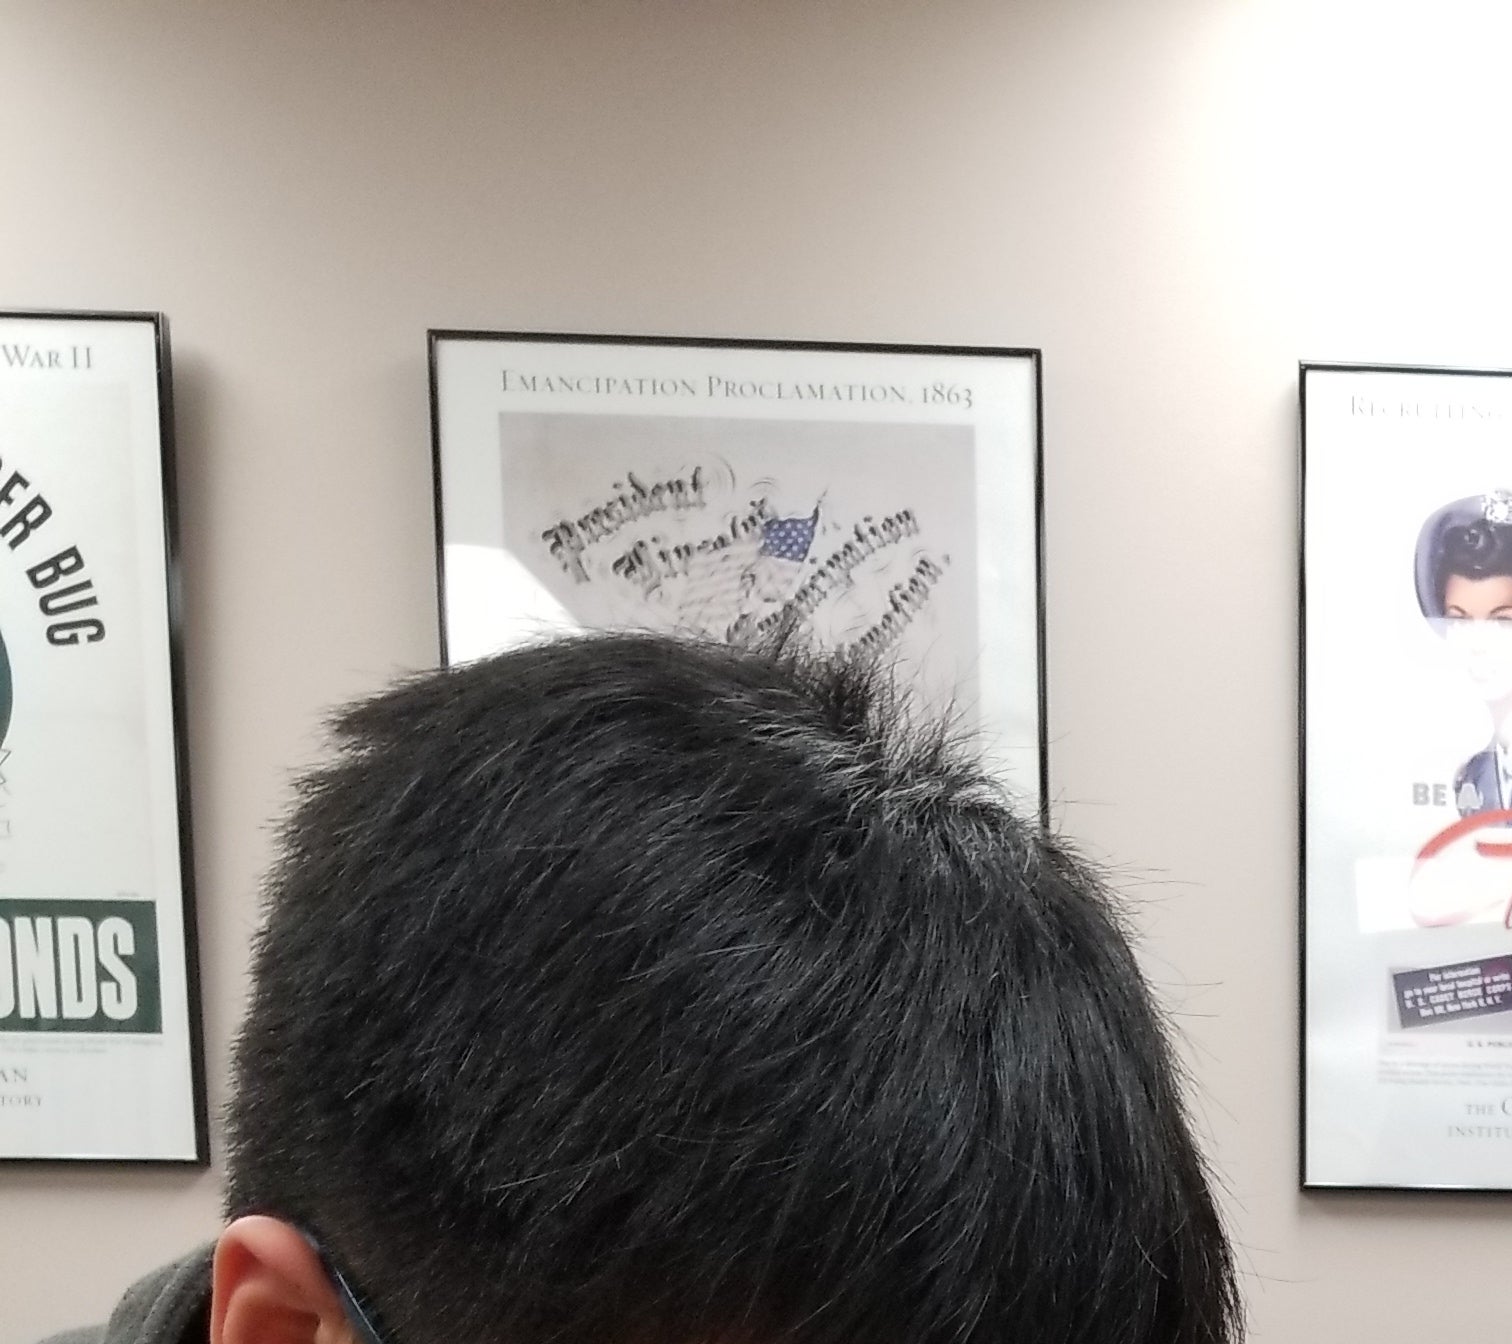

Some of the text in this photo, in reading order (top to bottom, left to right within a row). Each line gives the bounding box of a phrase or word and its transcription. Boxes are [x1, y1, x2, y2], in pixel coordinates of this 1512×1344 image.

[71, 345, 93, 370] II
[921, 382, 973, 409] 1863
[25, 544, 106, 647] BUG
[1412, 782, 1447, 807] BE
[1464, 1103, 1495, 1116] THE
